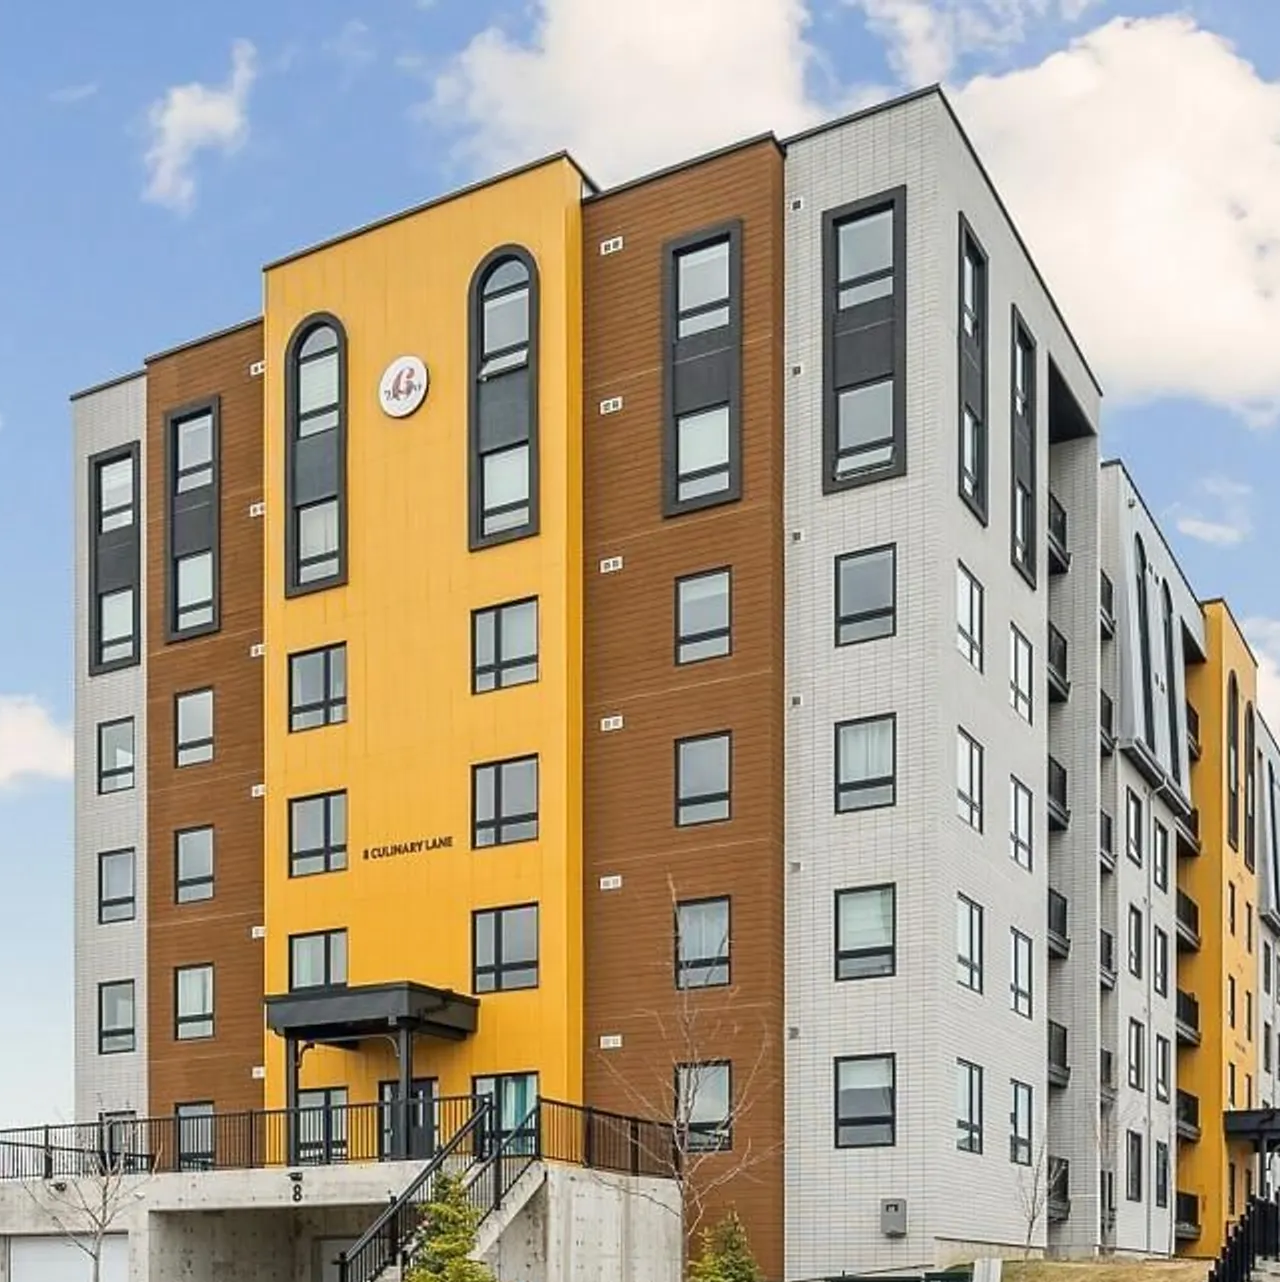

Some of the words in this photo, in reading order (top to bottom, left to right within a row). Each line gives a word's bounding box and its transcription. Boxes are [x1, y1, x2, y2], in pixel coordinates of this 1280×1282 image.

[370, 840, 423, 859] CULINARY
[425, 836, 453, 851] LANE
[292, 1184, 302, 1202] 8
